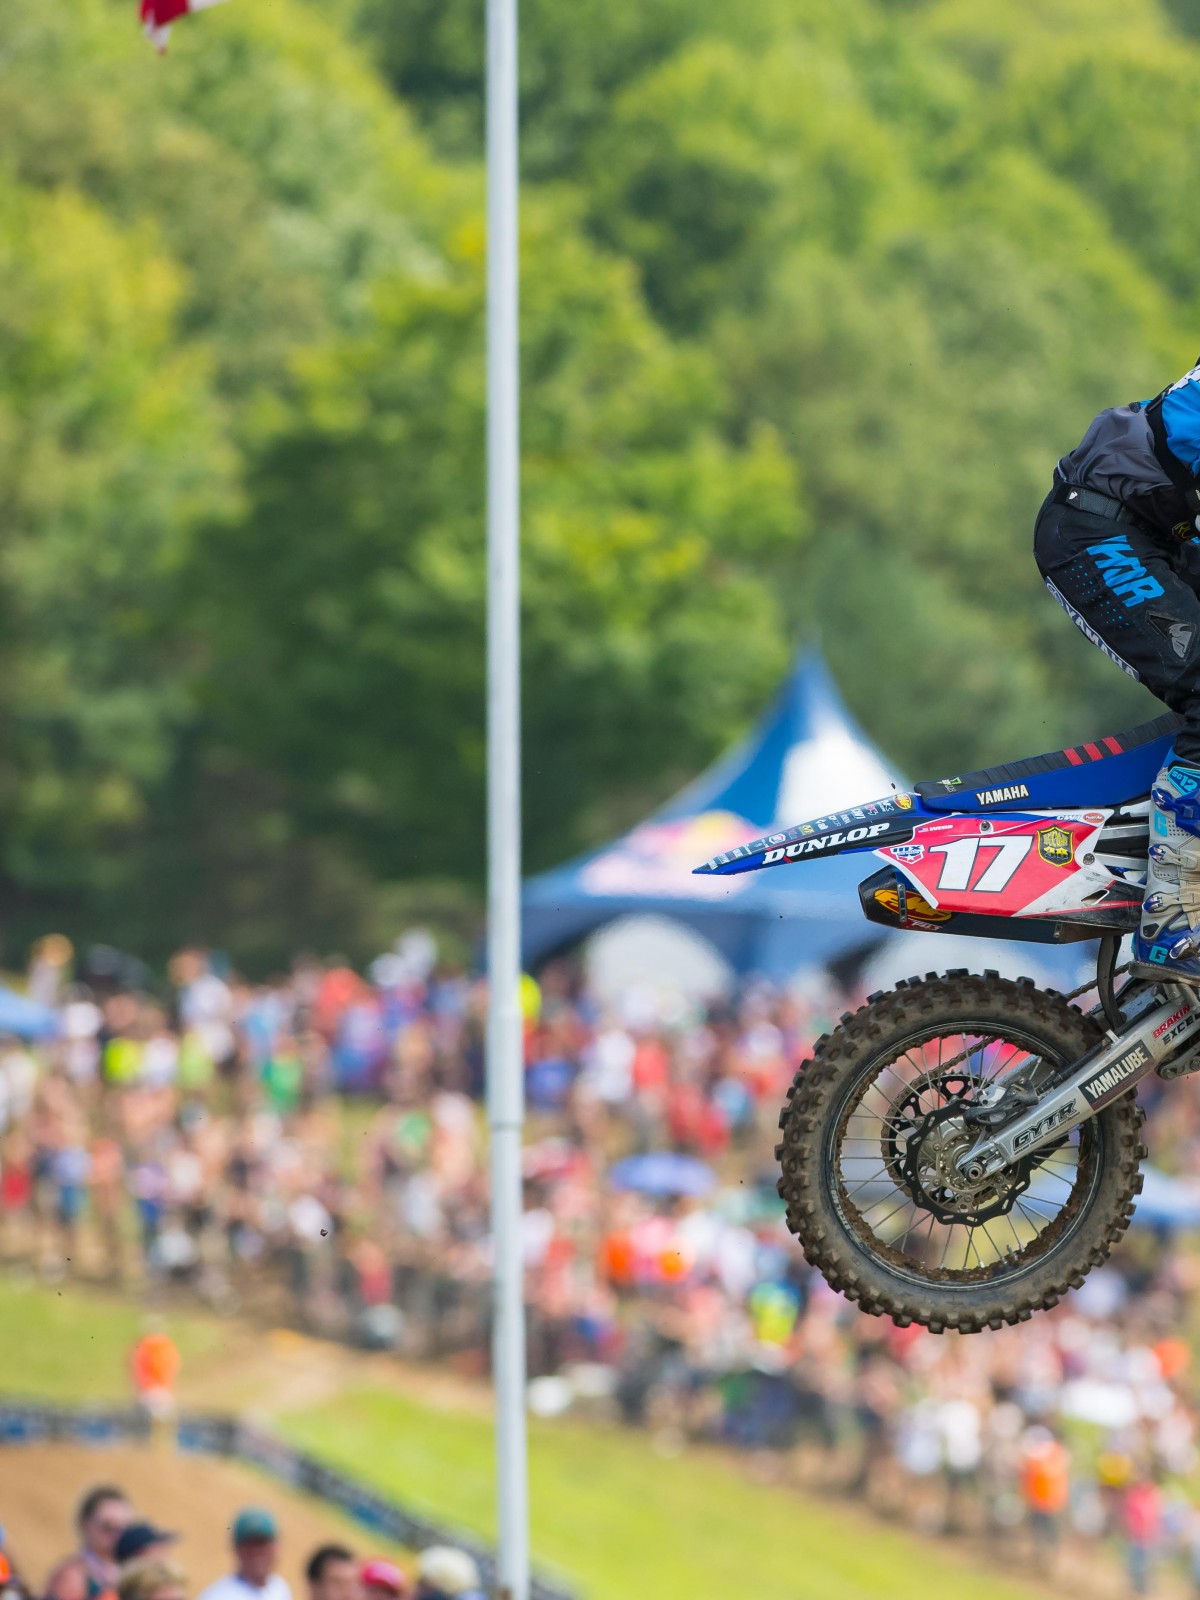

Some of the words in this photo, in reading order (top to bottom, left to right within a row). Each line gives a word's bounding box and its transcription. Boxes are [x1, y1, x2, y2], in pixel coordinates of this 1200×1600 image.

[976, 784, 1030, 805] YAMAHA
[762, 823, 890, 865] DUNLOP
[927, 835, 1035, 893] 17
[1152, 1004, 1191, 1039] BRAKIN
[1085, 1047, 1149, 1100] YAMALUBE
[1013, 1099, 1078, 1152] GYTR
